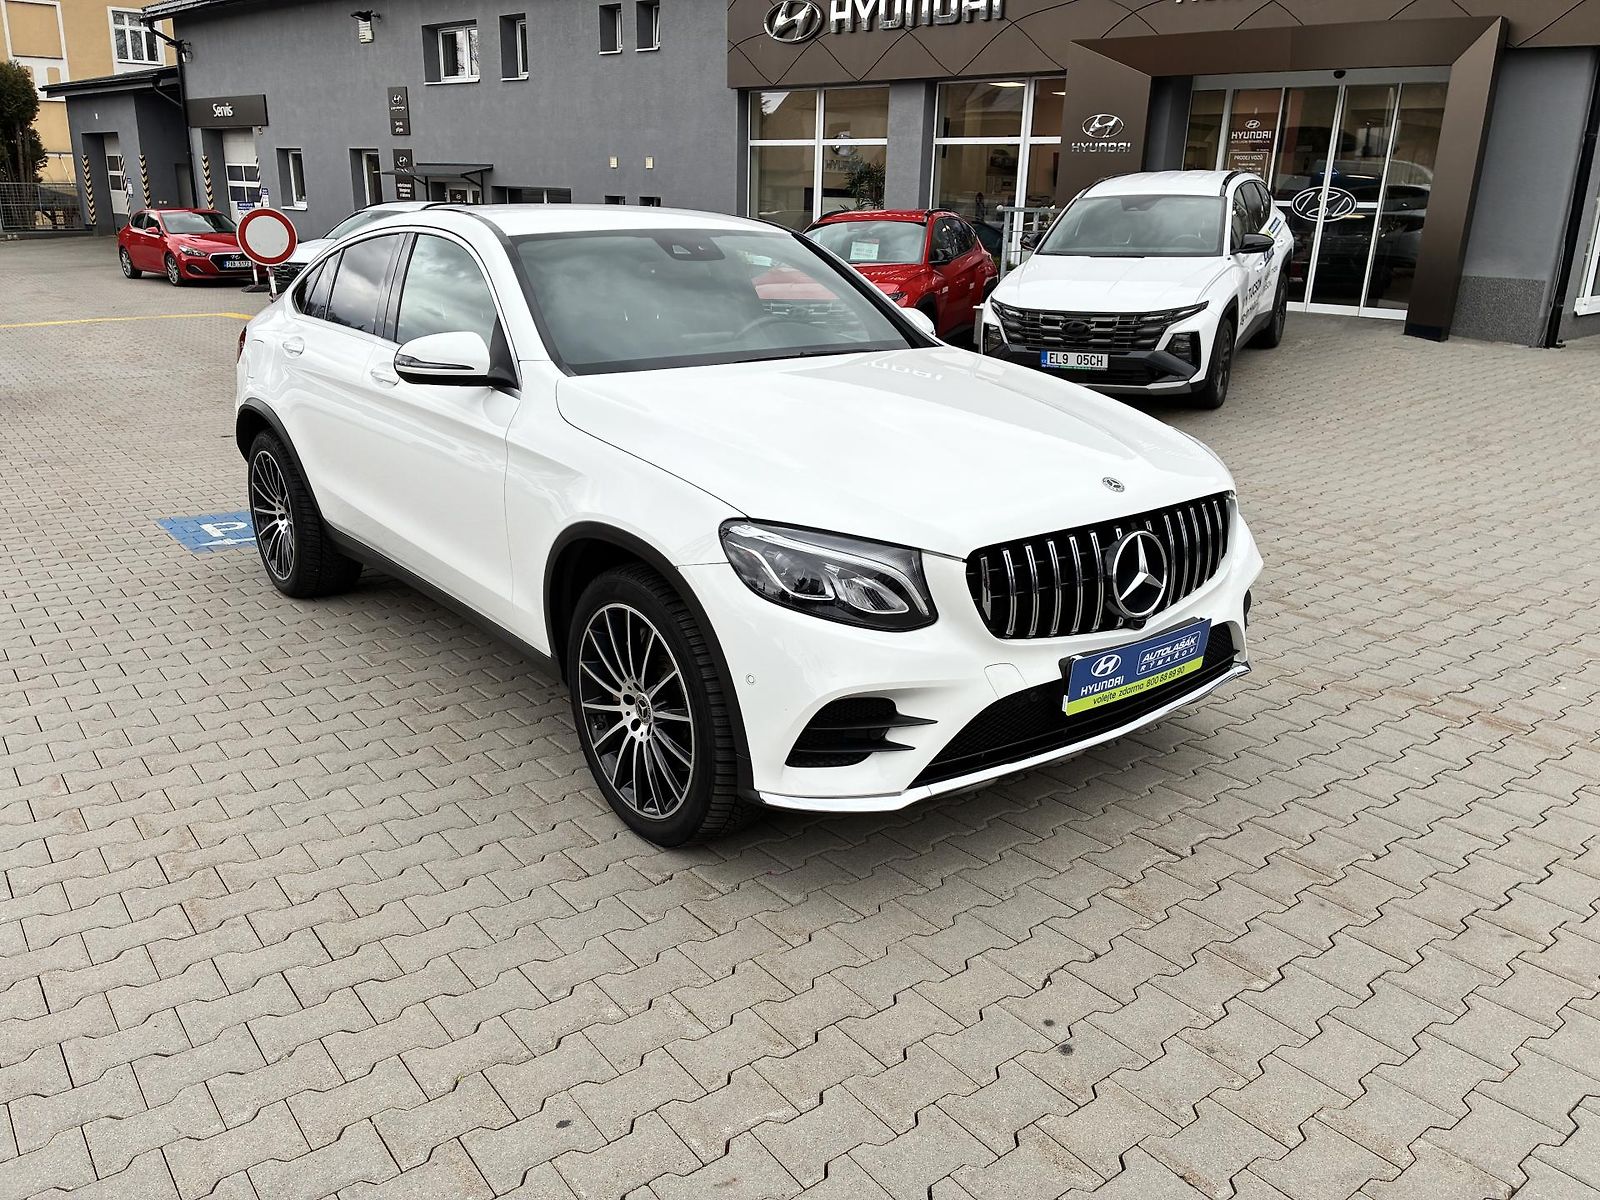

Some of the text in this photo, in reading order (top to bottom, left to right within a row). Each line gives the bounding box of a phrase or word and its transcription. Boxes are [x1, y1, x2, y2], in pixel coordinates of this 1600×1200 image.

[829, 0, 1004, 34] HYUNDAI
[212, 102, 234, 118] Servis
[1231, 131, 1272, 139] HYUNDAI
[1071, 142, 1131, 153] HYUNDAI
[1049, 353, 1103, 366] EL9 05CH
[200, 521, 248, 538] P
[1080, 675, 1124, 696] HYUNDAI
[1093, 691, 1117, 705] volejte
[1118, 683, 1144, 697] zdarma
[1146, 675, 1159, 688] 800
